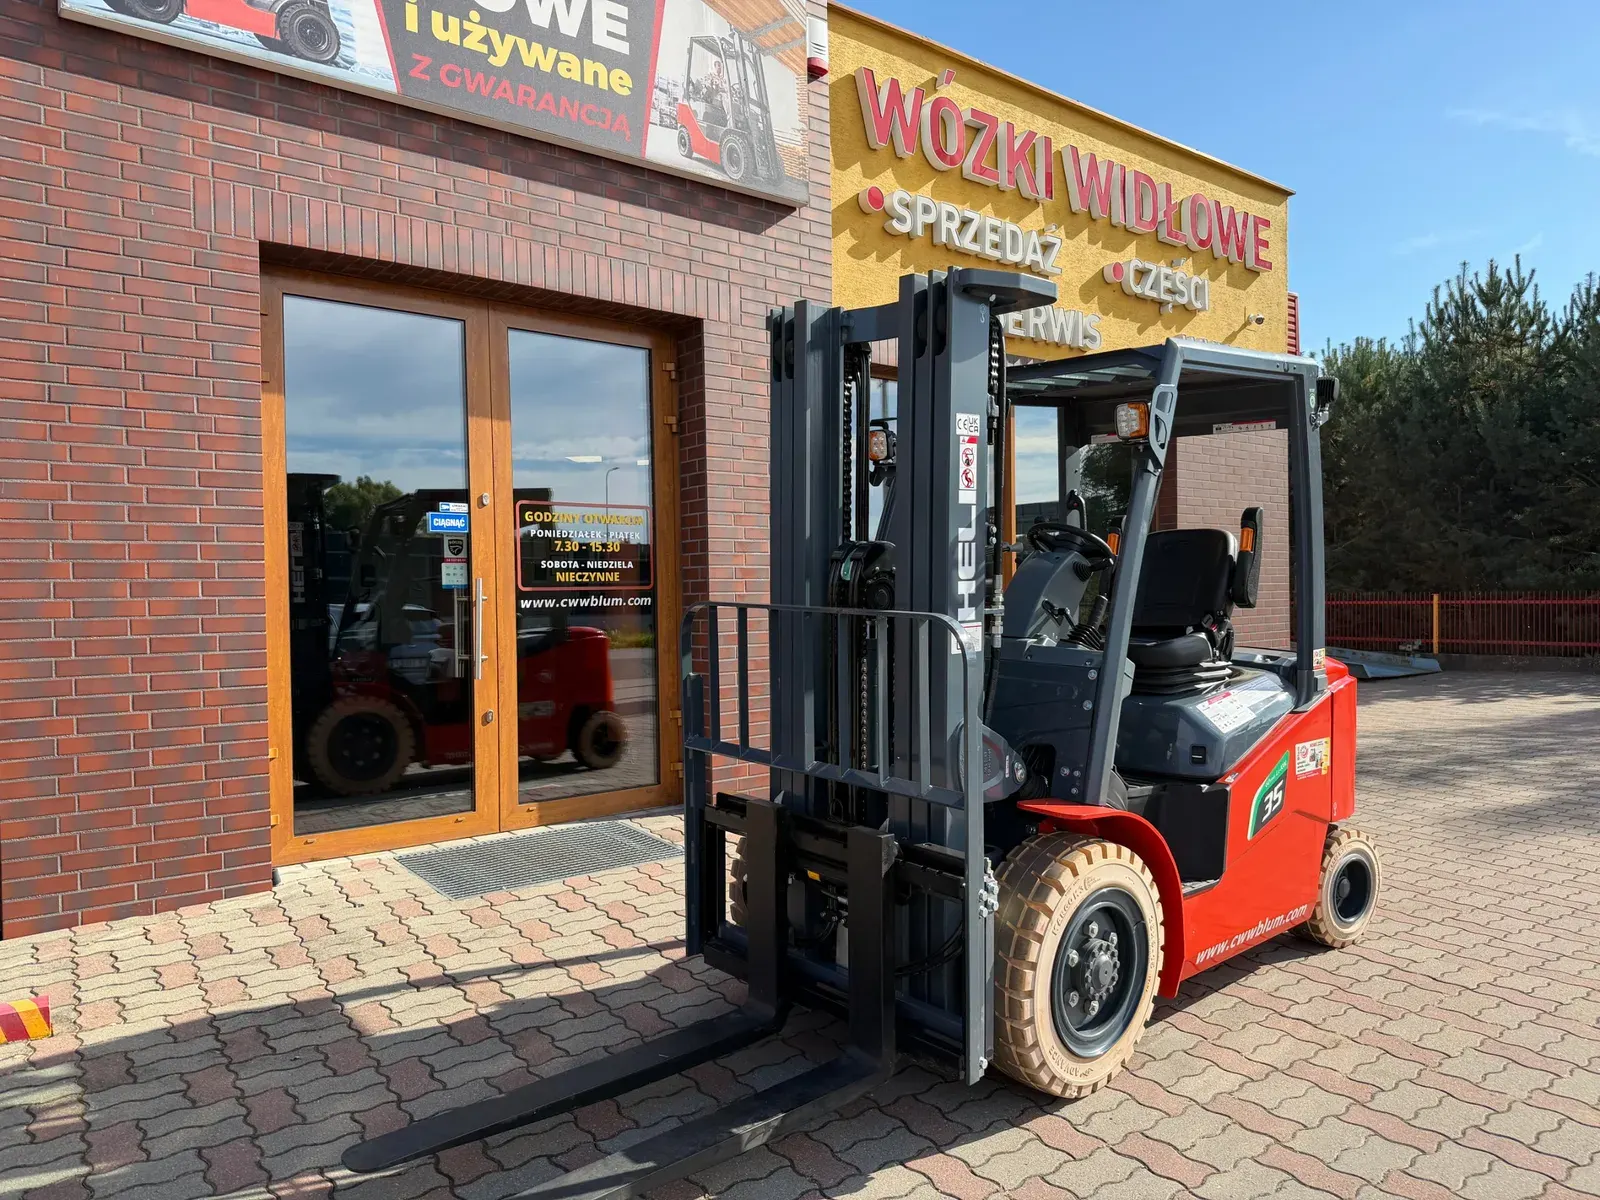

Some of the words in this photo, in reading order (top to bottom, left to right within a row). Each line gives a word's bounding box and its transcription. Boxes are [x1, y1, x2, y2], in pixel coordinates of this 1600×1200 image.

[405, 0, 419, 33] i
[431, 10, 633, 96] używane
[439, 63, 631, 142] GWARANCJĄ
[855, 66, 1054, 200] WÓZKI
[1062, 144, 1273, 272] WIDŁOWE
[884, 189, 1063, 276] SPRZEDAŻ
[1121, 258, 1210, 315] CZĘŚCI
[996, 304, 1102, 350] ERWIS
[433, 516, 465, 529] CIĄGNĄĆ
[524, 511, 580, 523] GODZINY
[530, 529, 602, 539] PONIEDZIAŁEK
[609, 531, 641, 541] PIĄTEK
[540, 560, 580, 568] SOBOTA
[587, 560, 633, 569] NIEDZIELA
[554, 541, 579, 552] 7.30
[590, 541, 620, 552] 15.30
[957, 490, 976, 621] HELI
[556, 572, 620, 582] NIECZYNNE
[520, 595, 652, 609] www.cwwblum.com
[1261, 779, 1284, 823] 35
[1195, 904, 1308, 965] www.cwwblum.com
